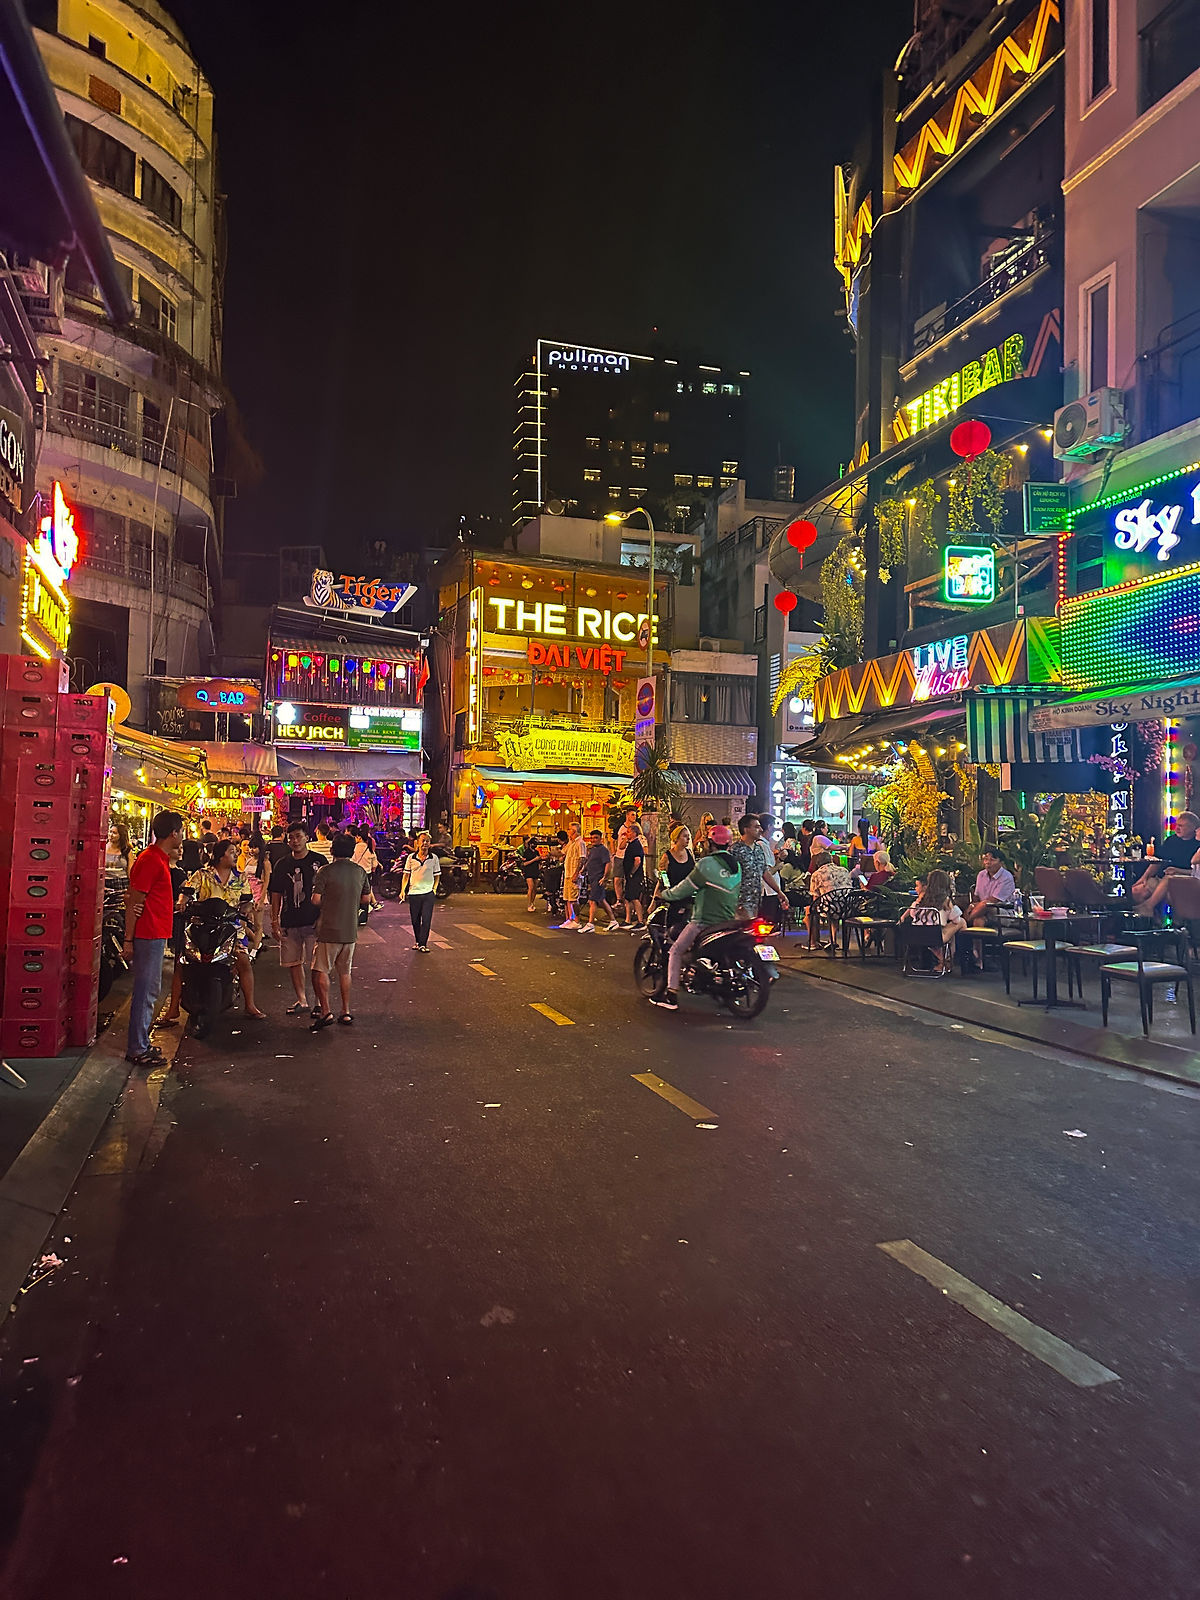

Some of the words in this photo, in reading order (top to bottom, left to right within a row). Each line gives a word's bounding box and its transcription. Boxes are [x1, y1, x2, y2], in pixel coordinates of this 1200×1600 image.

[549, 349, 630, 371] pullman
[558, 363, 621, 374] HOTELS
[961, 333, 1024, 405] BAR
[1115, 499, 1183, 561] Sky
[339, 574, 402, 608] Tiger
[488, 597, 567, 635] THE
[527, 642, 570, 672] ĐẠI
[575, 643, 627, 676] VIỆT
[914, 635, 968, 676] LIVE
[220, 691, 244, 705] BAR
[1095, 700, 1133, 717] Sky
[1141, 688, 1200, 714] Night
[277, 724, 306, 738] HEY
[306, 725, 344, 740] JACK
[303, 712, 342, 723] Coffee
[772, 768, 784, 840] TATTOO
